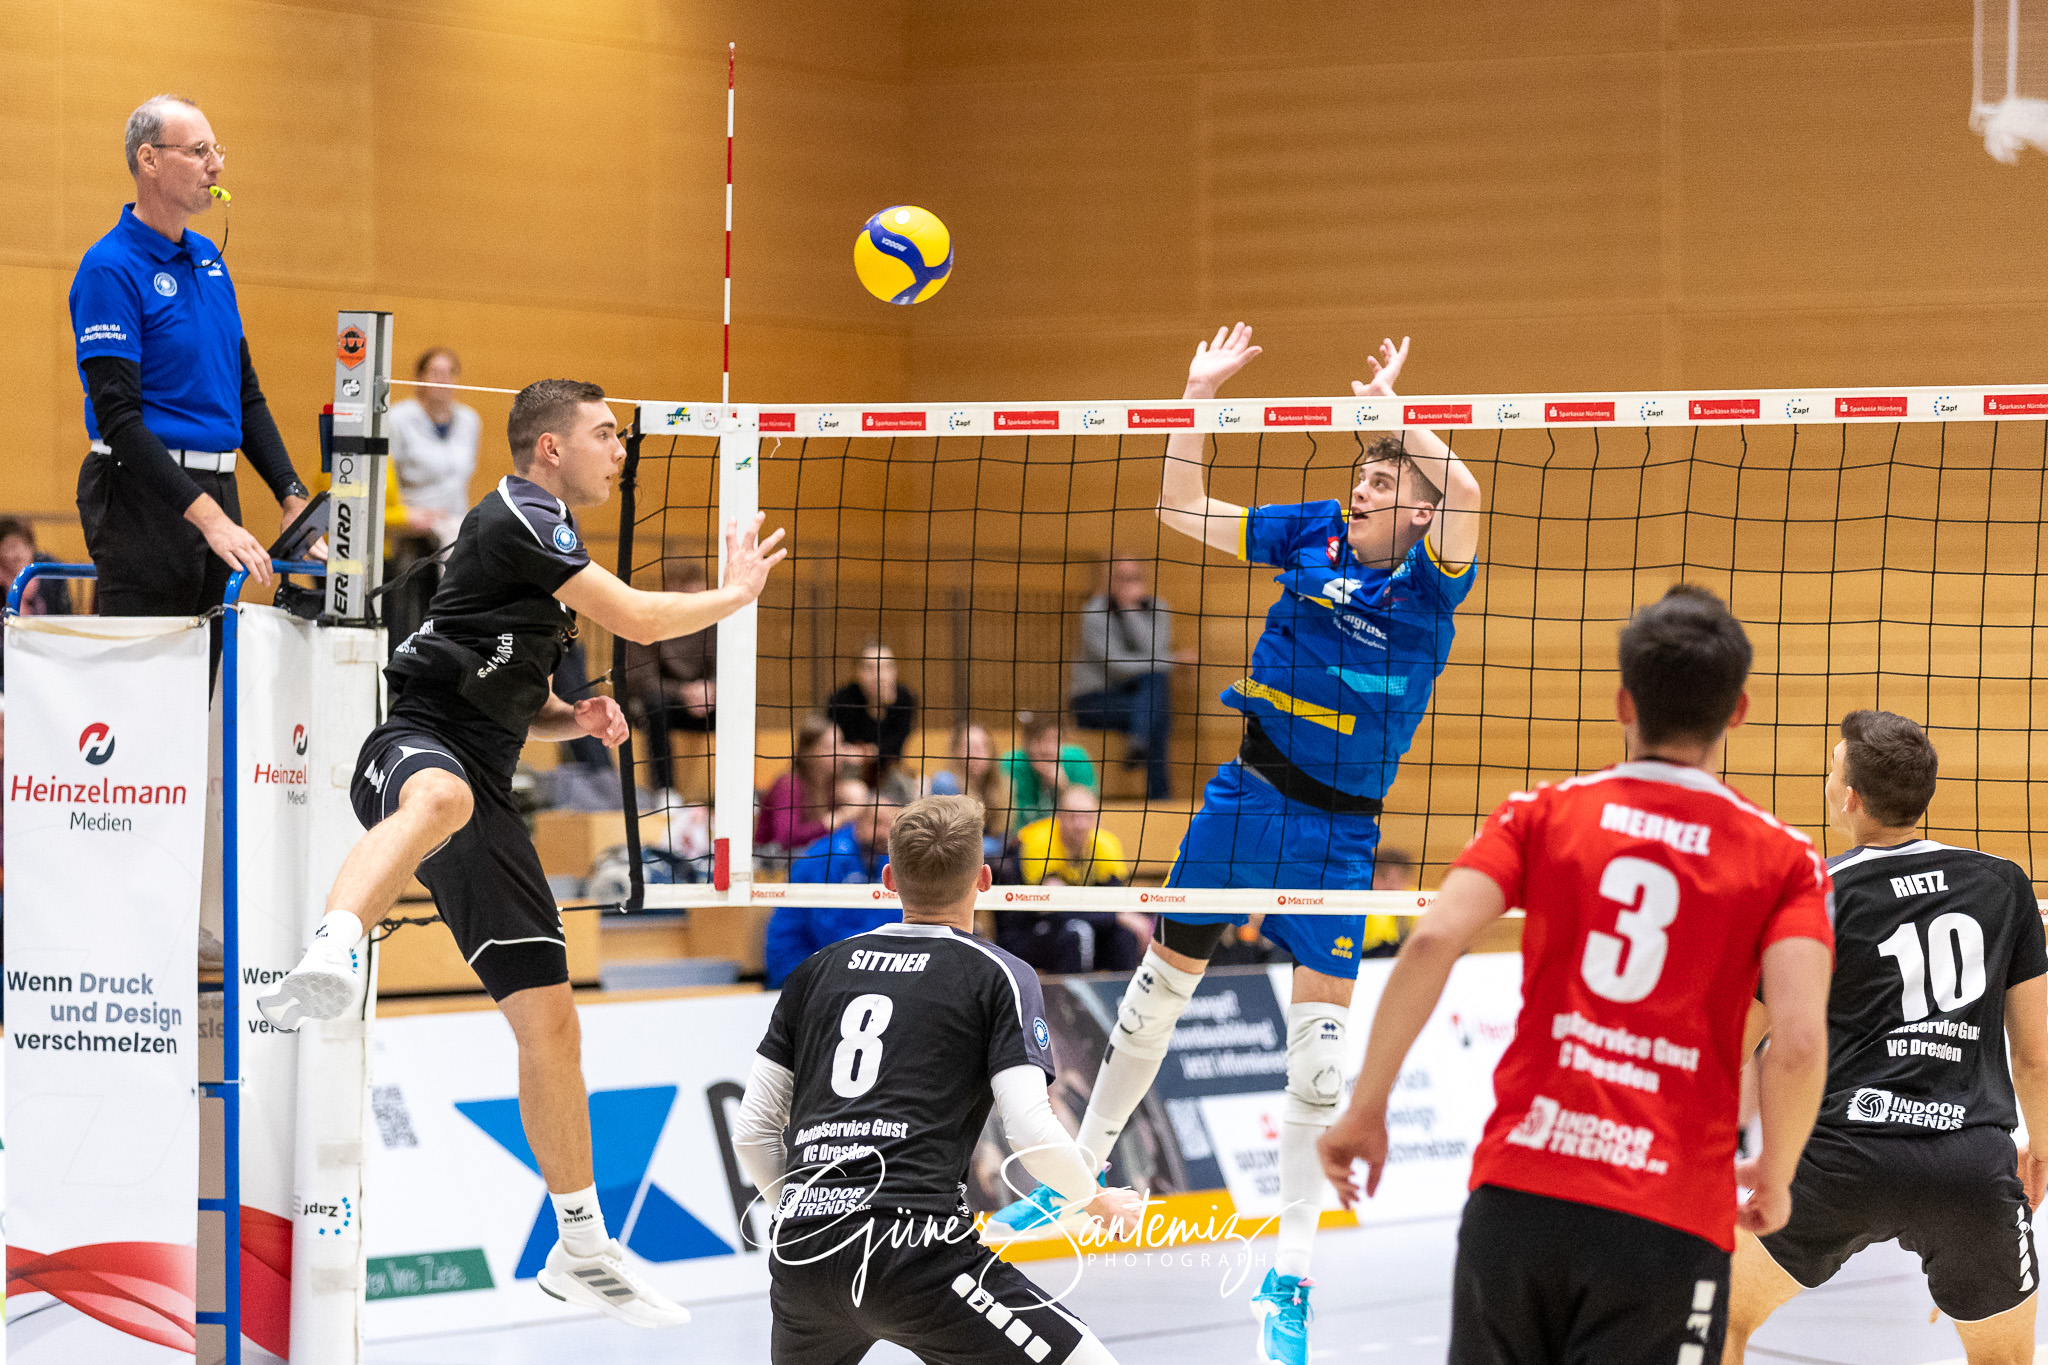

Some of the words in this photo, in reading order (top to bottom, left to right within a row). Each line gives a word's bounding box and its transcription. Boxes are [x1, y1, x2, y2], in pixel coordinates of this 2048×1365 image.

[1504, 412, 1520, 420] Zapf
[1792, 407, 1810, 415] Zapf
[1940, 404, 1958, 412] Zapf
[1998, 402, 2026, 411] Sparkasse
[2027, 401, 2048, 410] Nürnber
[824, 421, 839, 429] Zapf
[955, 419, 970, 428] Zapf
[1089, 418, 1105, 426] Zapf
[1225, 416, 1241, 424] Zapf
[1363, 414, 1379, 422] Zapf
[254, 763, 307, 785] Heinzel
[11, 775, 187, 805] Heinzelmann
[70, 811, 132, 832] Medien
[1600, 803, 1712, 856] MERKEL
[1889, 870, 1949, 899] RIETZ
[1015, 893, 1050, 902] Marmot
[1150, 894, 1186, 903] Marmot
[1288, 896, 1324, 905] Marmot
[1581, 855, 1680, 1004] 3
[847, 949, 931, 972] SITTNER
[1877, 912, 1987, 1022] 10
[7, 971, 73, 993] Wenn
[79, 972, 155, 995] Druck
[243, 968, 291, 984] Wen
[50, 1002, 98, 1023] und
[105, 1002, 182, 1031] Design
[14, 1031, 178, 1054] verschmelzen
[830, 993, 894, 1099] 8
[1886, 1039, 1907, 1057] VC
[1910, 1039, 1962, 1062] Dresden
[1892, 1096, 1966, 1120] INDOOR
[872, 1119, 909, 1139] Gust
[1556, 1108, 1654, 1150] INDOOR
[1889, 1111, 1963, 1132] TRENDS
[803, 1144, 818, 1163] VC
[802, 1187, 866, 1203] INDOOR
[303, 1202, 338, 1217] Zapf
